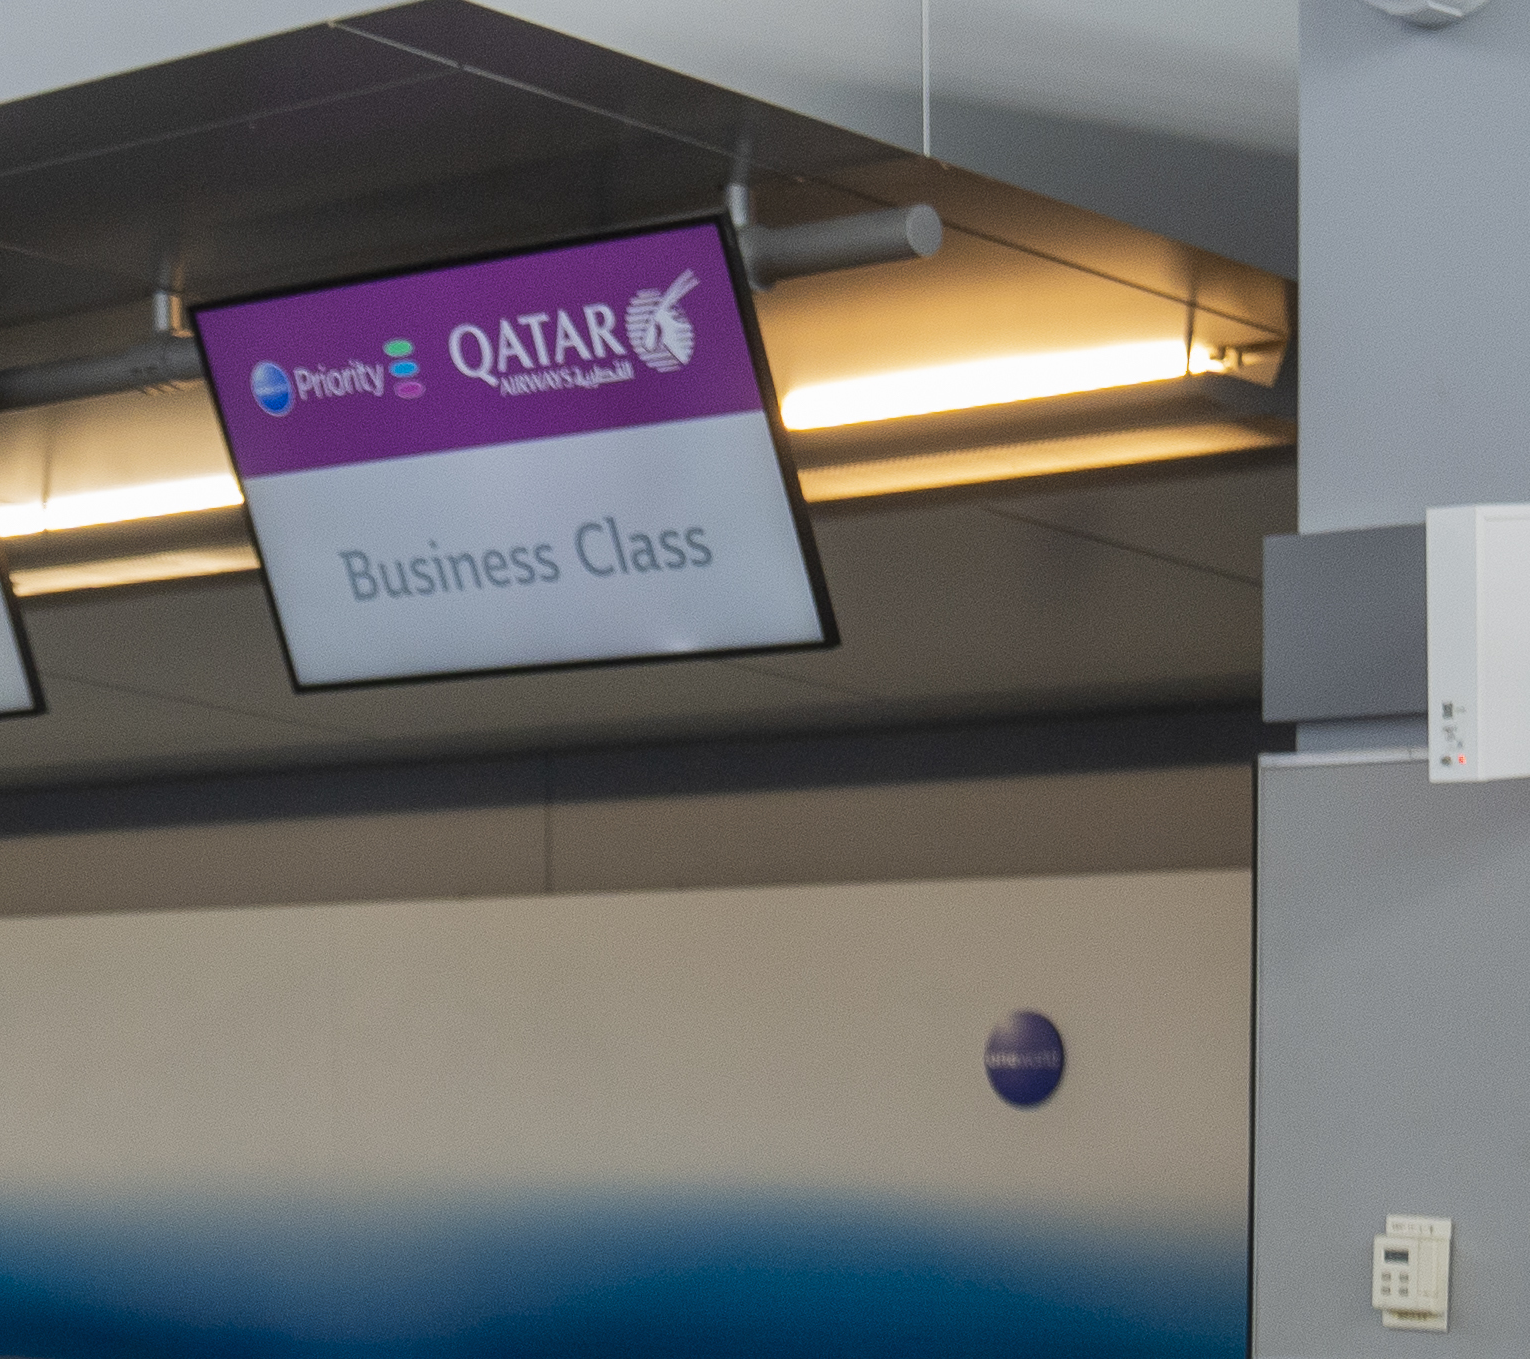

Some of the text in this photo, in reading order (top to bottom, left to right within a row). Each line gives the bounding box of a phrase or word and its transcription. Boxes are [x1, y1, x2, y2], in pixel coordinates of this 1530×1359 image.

[293, 359, 384, 400] Priority
[448, 302, 627, 387] QATAR
[339, 516, 714, 602] Business Class
